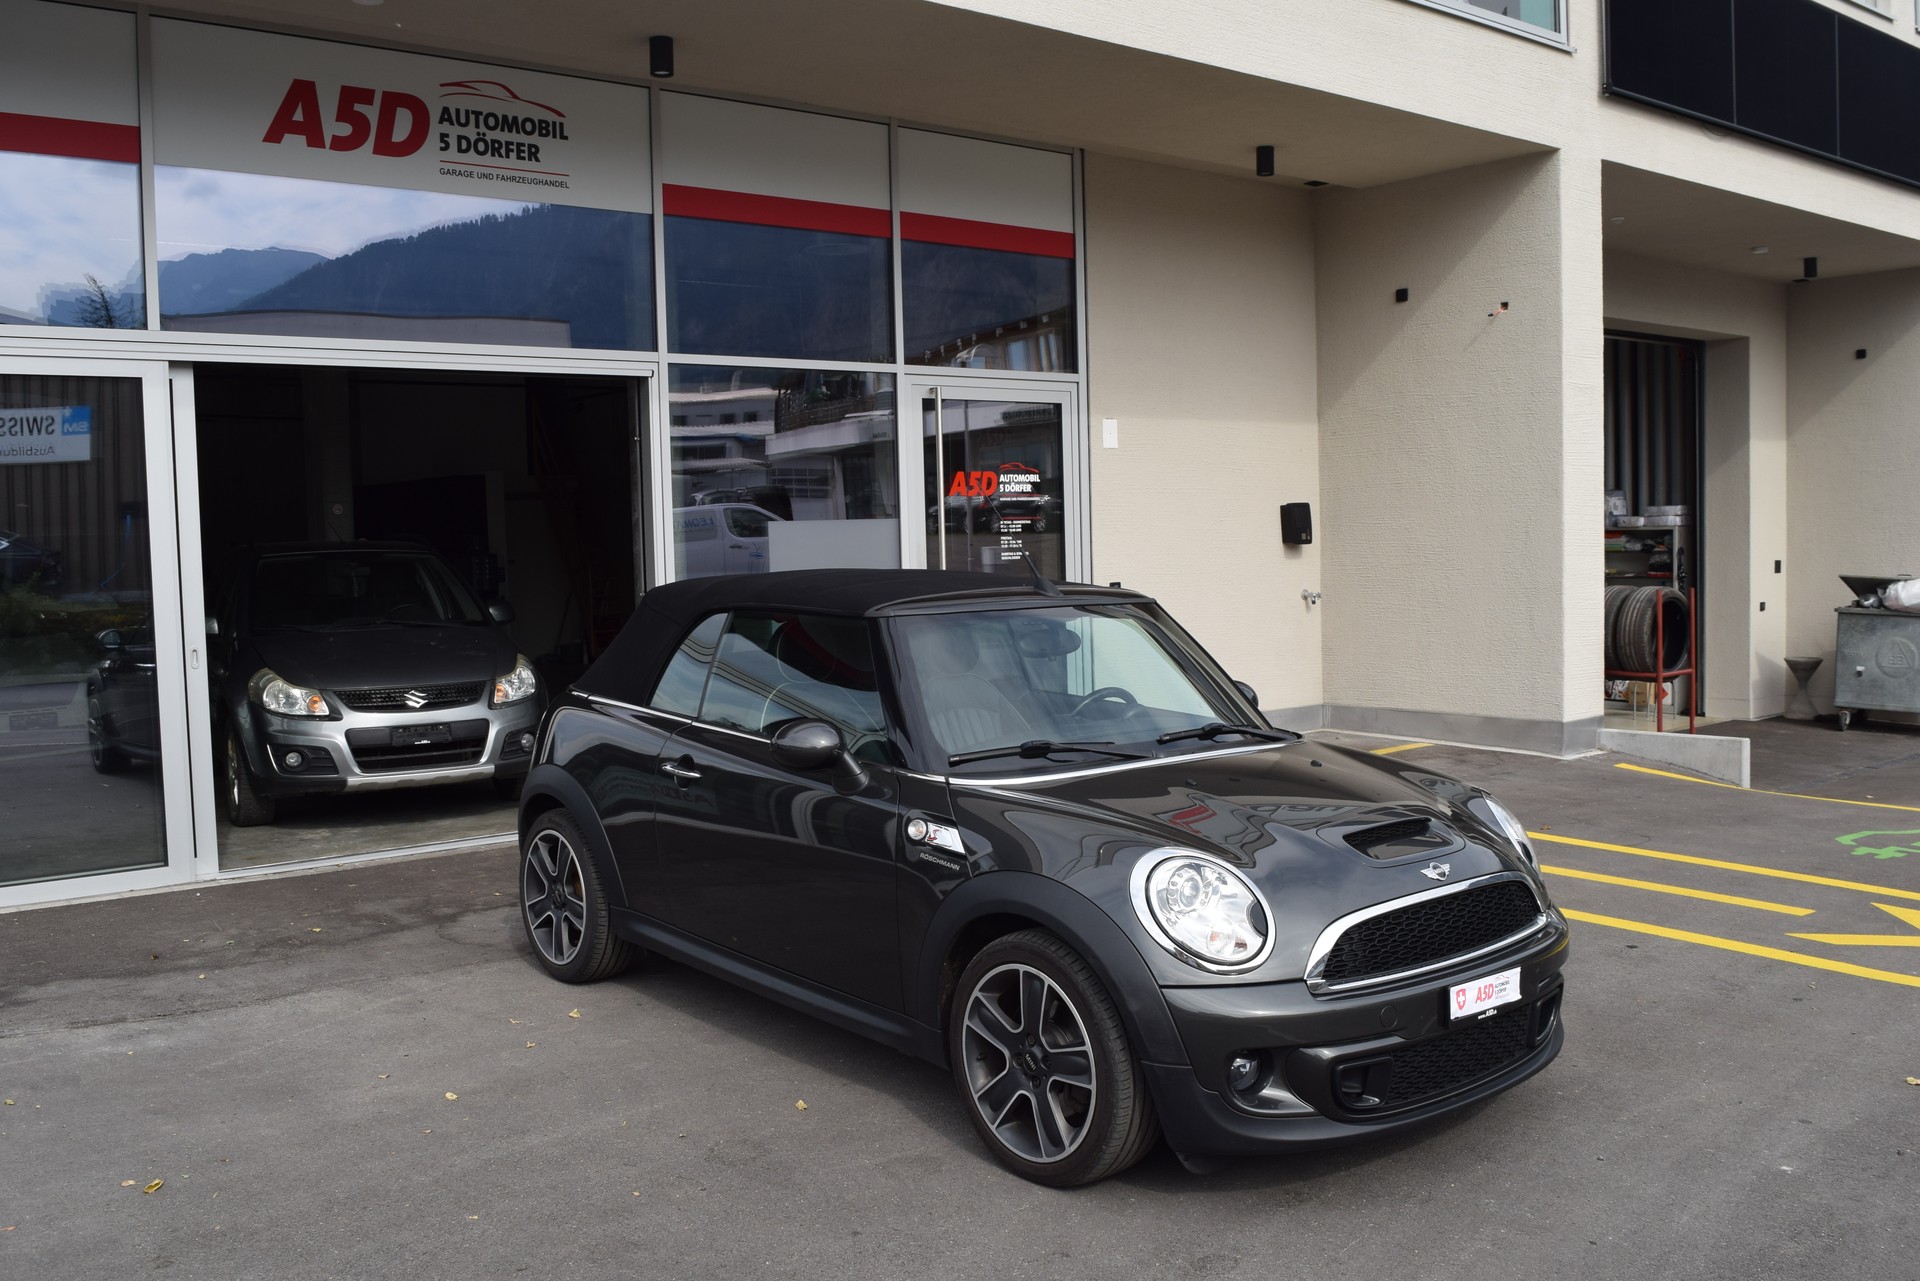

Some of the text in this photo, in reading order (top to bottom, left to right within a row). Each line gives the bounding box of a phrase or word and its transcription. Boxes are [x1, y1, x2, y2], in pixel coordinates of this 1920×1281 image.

[262, 78, 431, 158] A5D
[438, 106, 569, 140] AUTOMOBIL
[439, 132, 541, 163] 5 DÖRFER
[439, 167, 570, 189] GARAGE UND FAHRZEUGHANDEL
[948, 471, 998, 496] A5D
[999, 473, 1041, 483] AUTOMOBIL
[1005, 483, 1032, 492] DÖRFER
[919, 852, 961, 871] RÖSCHMANN
[1475, 983, 1494, 1003] A5D
